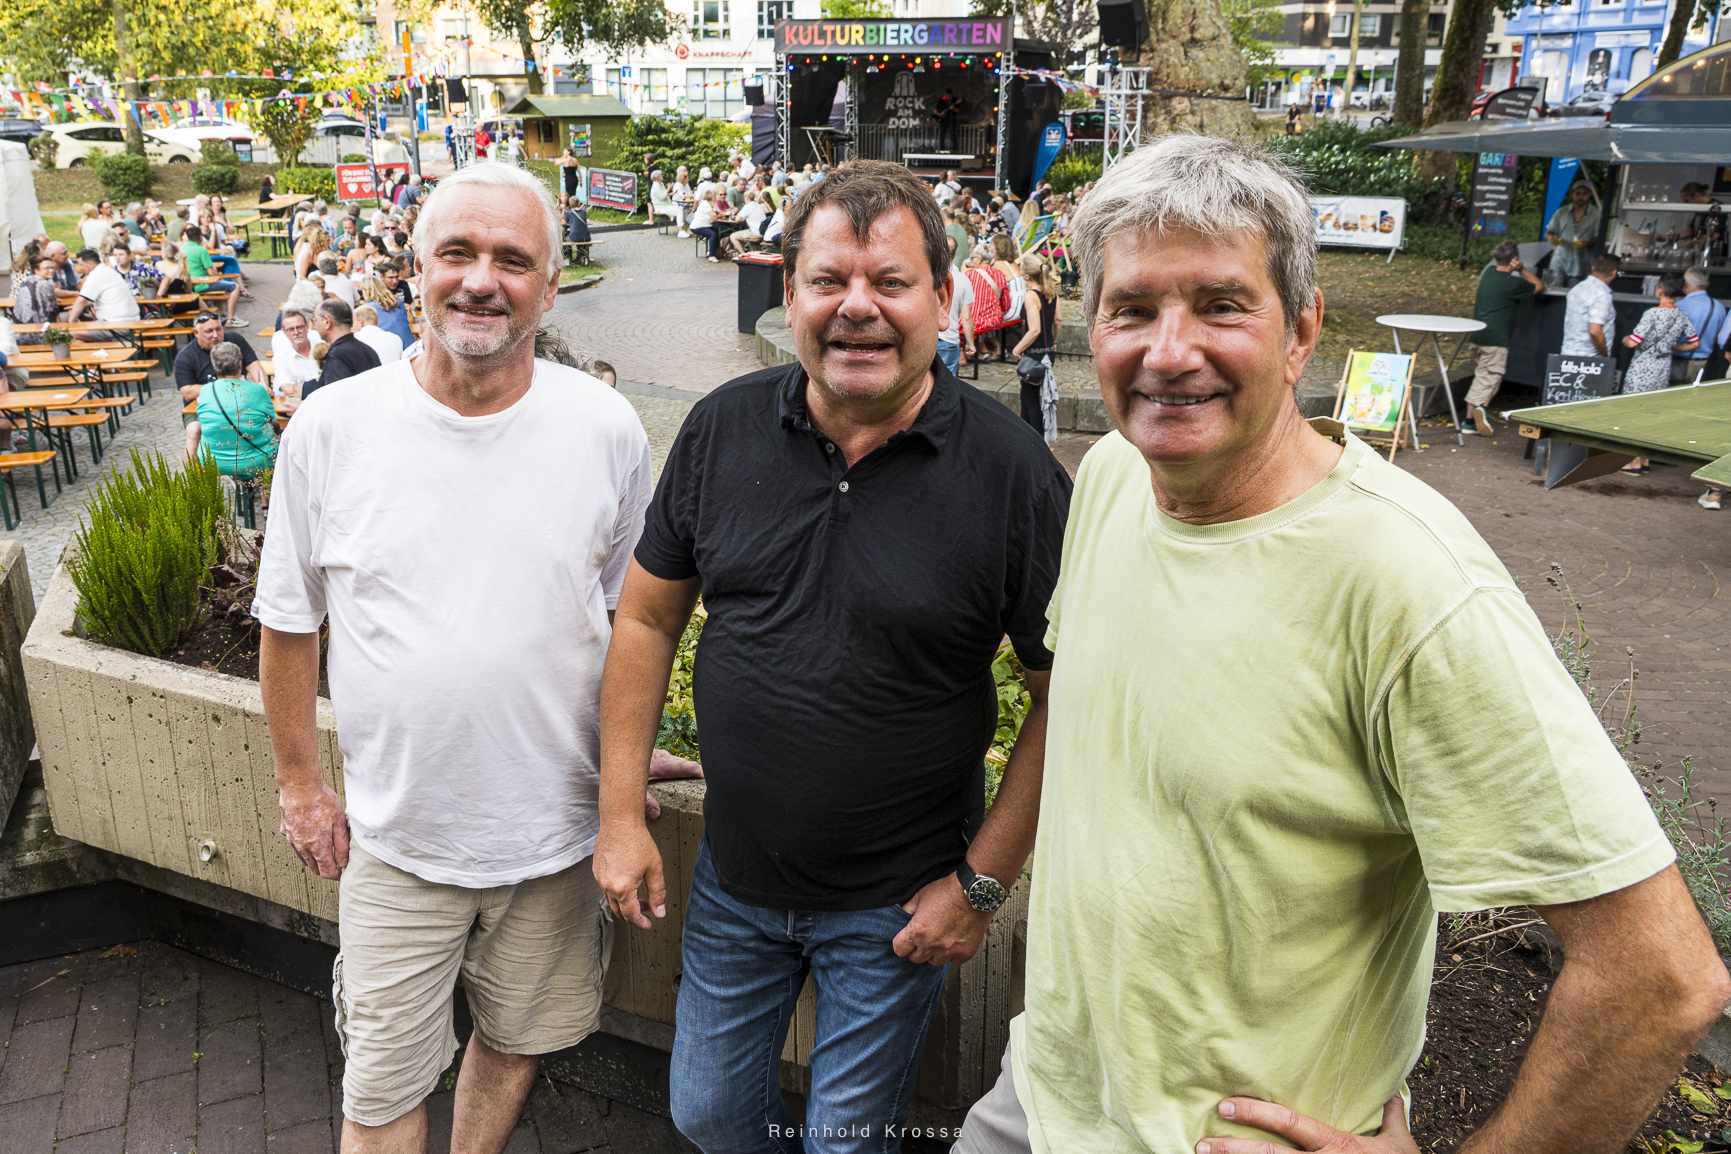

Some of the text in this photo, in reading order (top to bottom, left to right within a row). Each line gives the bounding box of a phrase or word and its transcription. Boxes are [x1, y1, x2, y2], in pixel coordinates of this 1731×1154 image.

[785, 23, 1002, 46] KULTURBIERGARTEN
[885, 97, 926, 110] ROCK
[897, 108, 913, 117] AM
[888, 116, 920, 129] DOM
[1548, 372, 1588, 390] EC &
